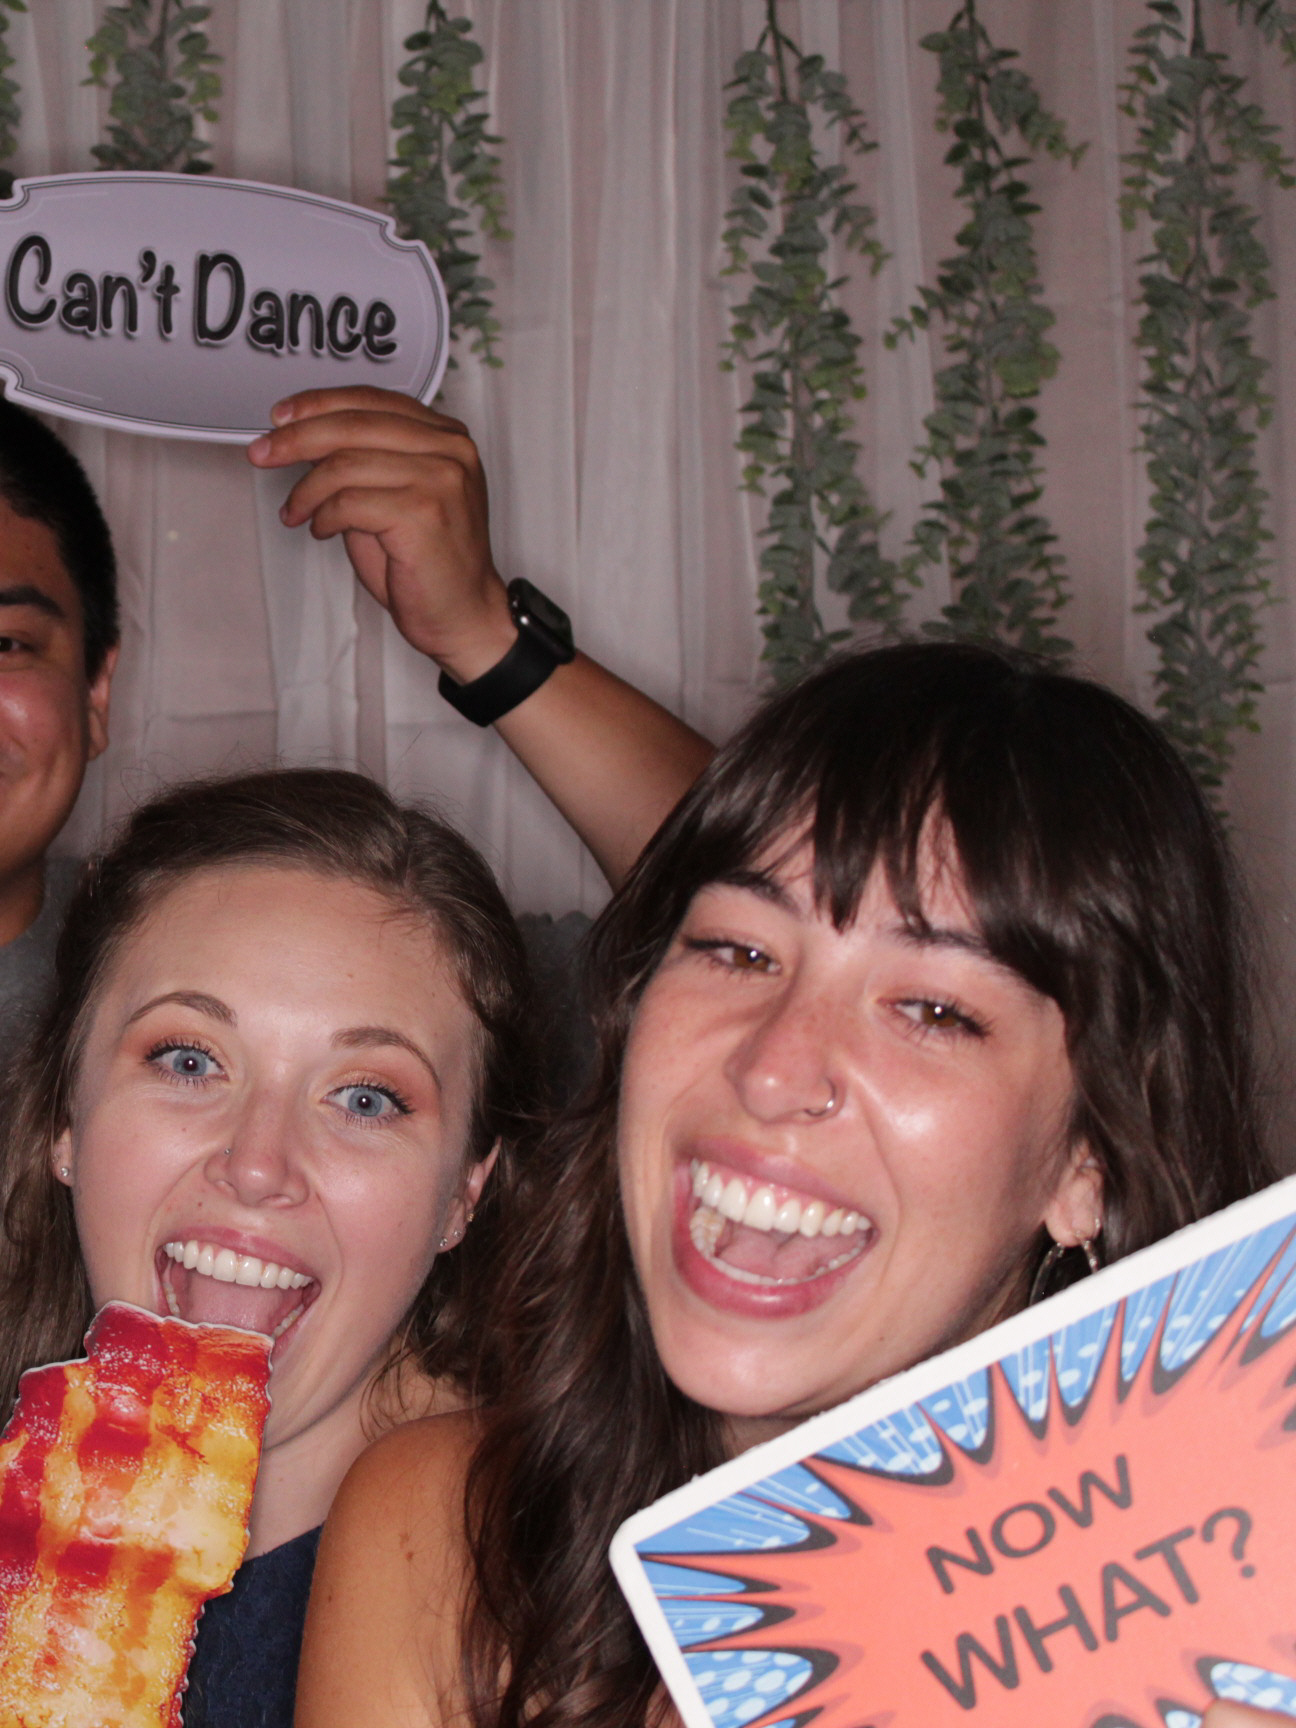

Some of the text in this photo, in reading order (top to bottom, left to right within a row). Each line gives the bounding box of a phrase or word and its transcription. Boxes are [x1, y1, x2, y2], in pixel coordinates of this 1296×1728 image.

[7, 235, 398, 357] Can't Dance
[925, 1454, 1131, 1595] NOW
[921, 1507, 1256, 1710] WHAT?
